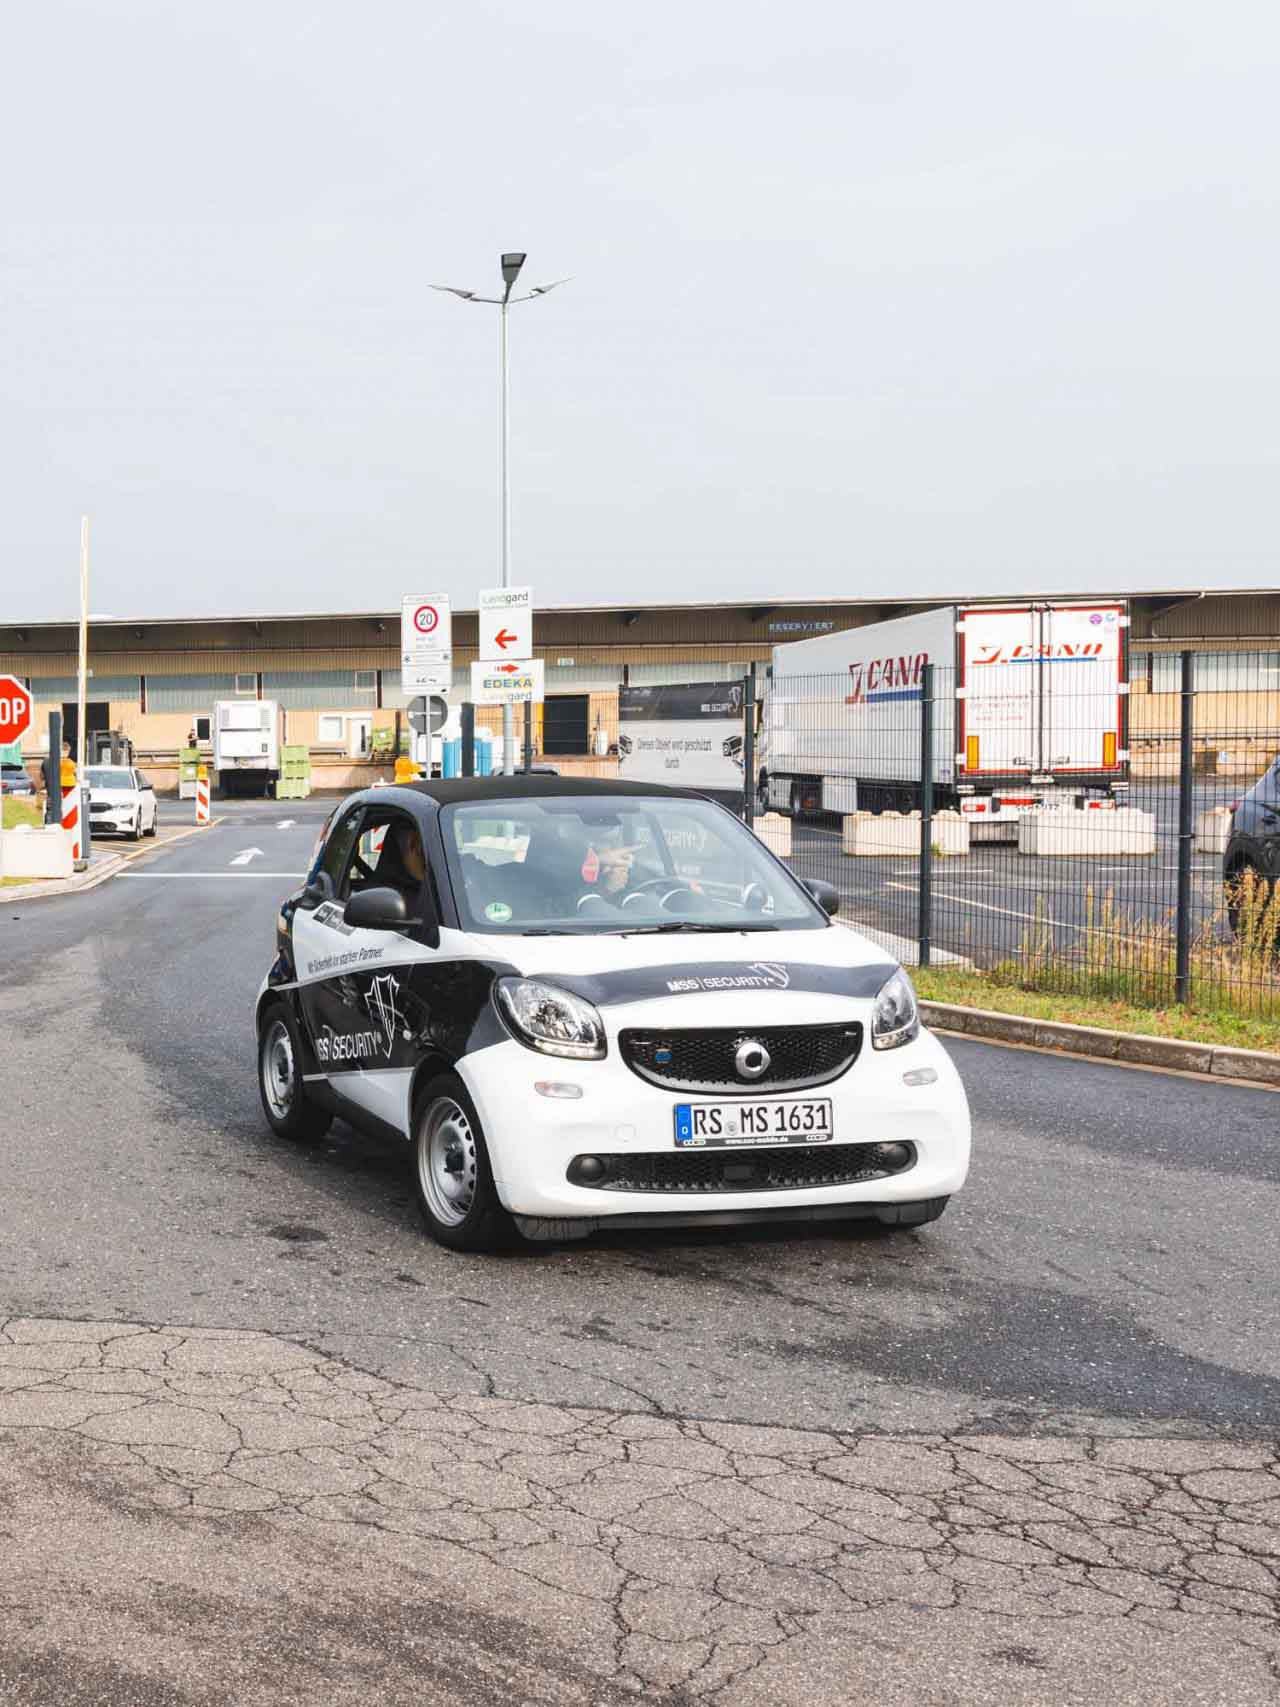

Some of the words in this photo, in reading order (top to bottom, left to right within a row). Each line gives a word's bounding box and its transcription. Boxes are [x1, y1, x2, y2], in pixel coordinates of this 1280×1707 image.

[419, 613, 433, 626] 20
[483, 678, 532, 688] EDEKA
[666, 979, 699, 992] MSS
[703, 976, 769, 988] SECURITY
[332, 1030, 378, 1060] SECURITY
[693, 1108, 722, 1135] RS
[740, 1106, 768, 1133] MS
[775, 1104, 829, 1132] 1631
